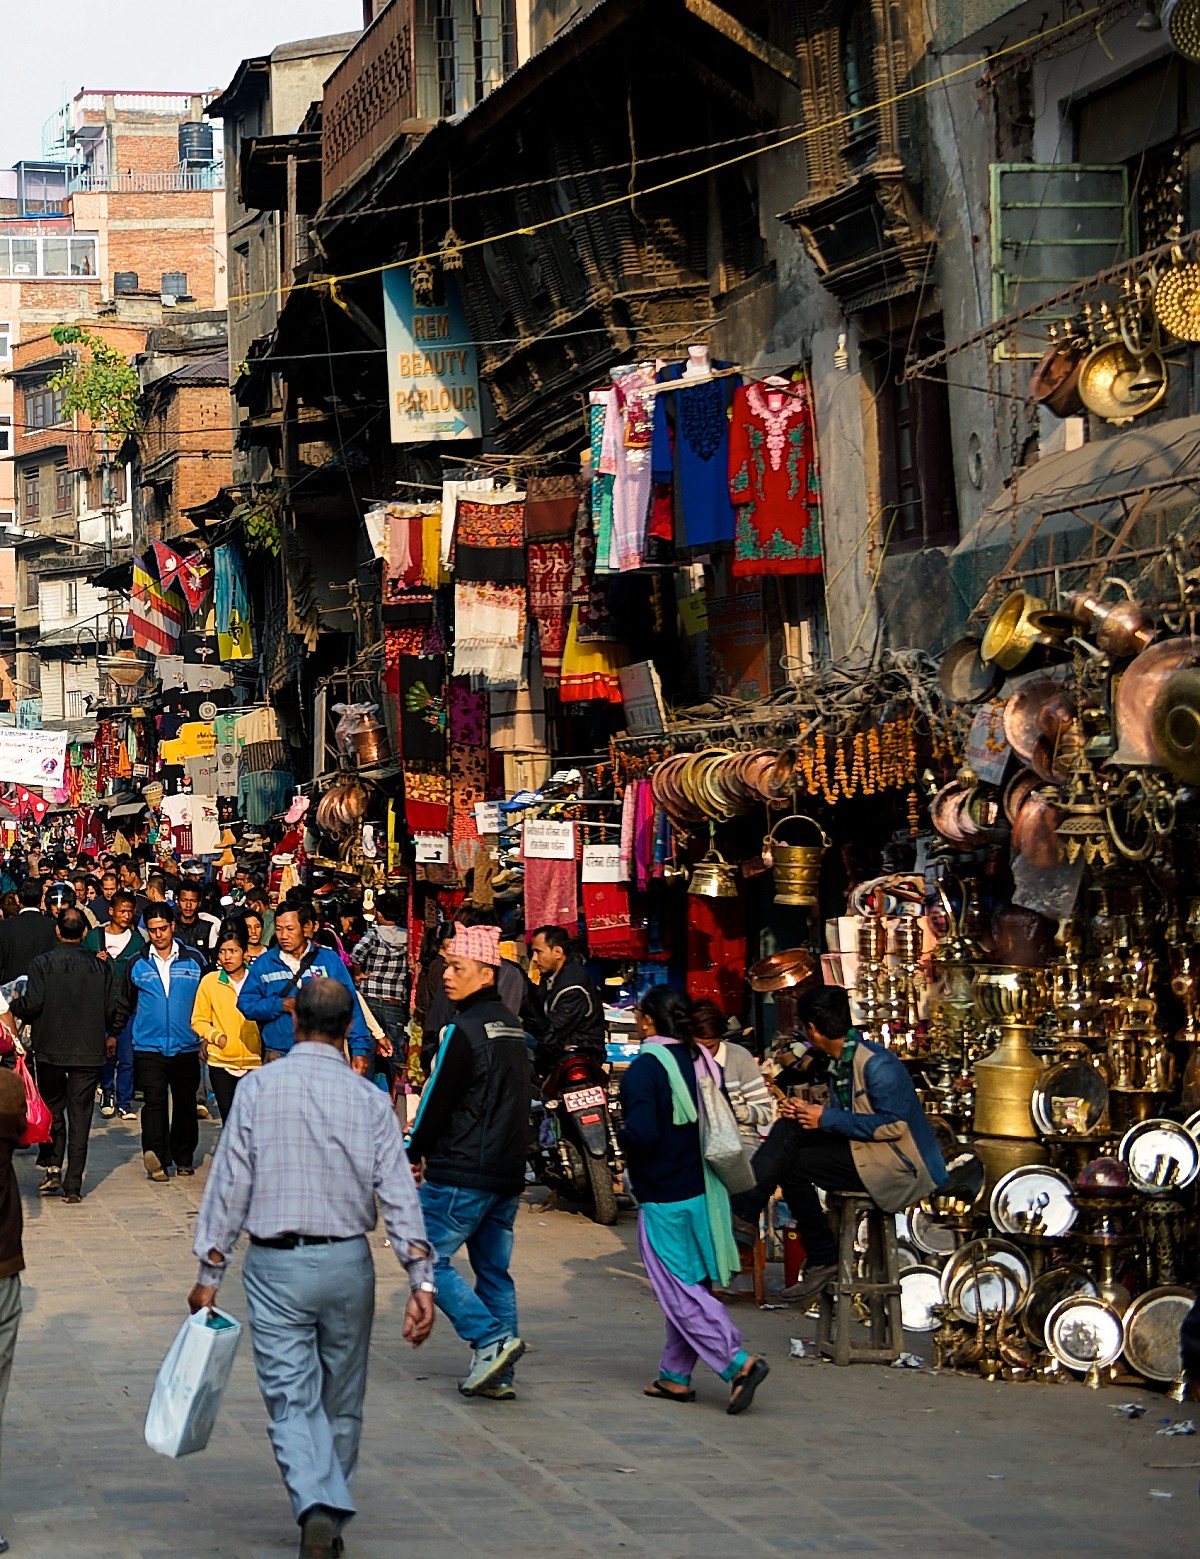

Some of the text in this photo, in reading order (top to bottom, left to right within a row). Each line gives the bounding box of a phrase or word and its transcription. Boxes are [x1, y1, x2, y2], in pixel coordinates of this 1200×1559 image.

[413, 315, 450, 338] REM
[399, 350, 468, 377] BEAUTY
[396, 385, 477, 413] PARLOUR
